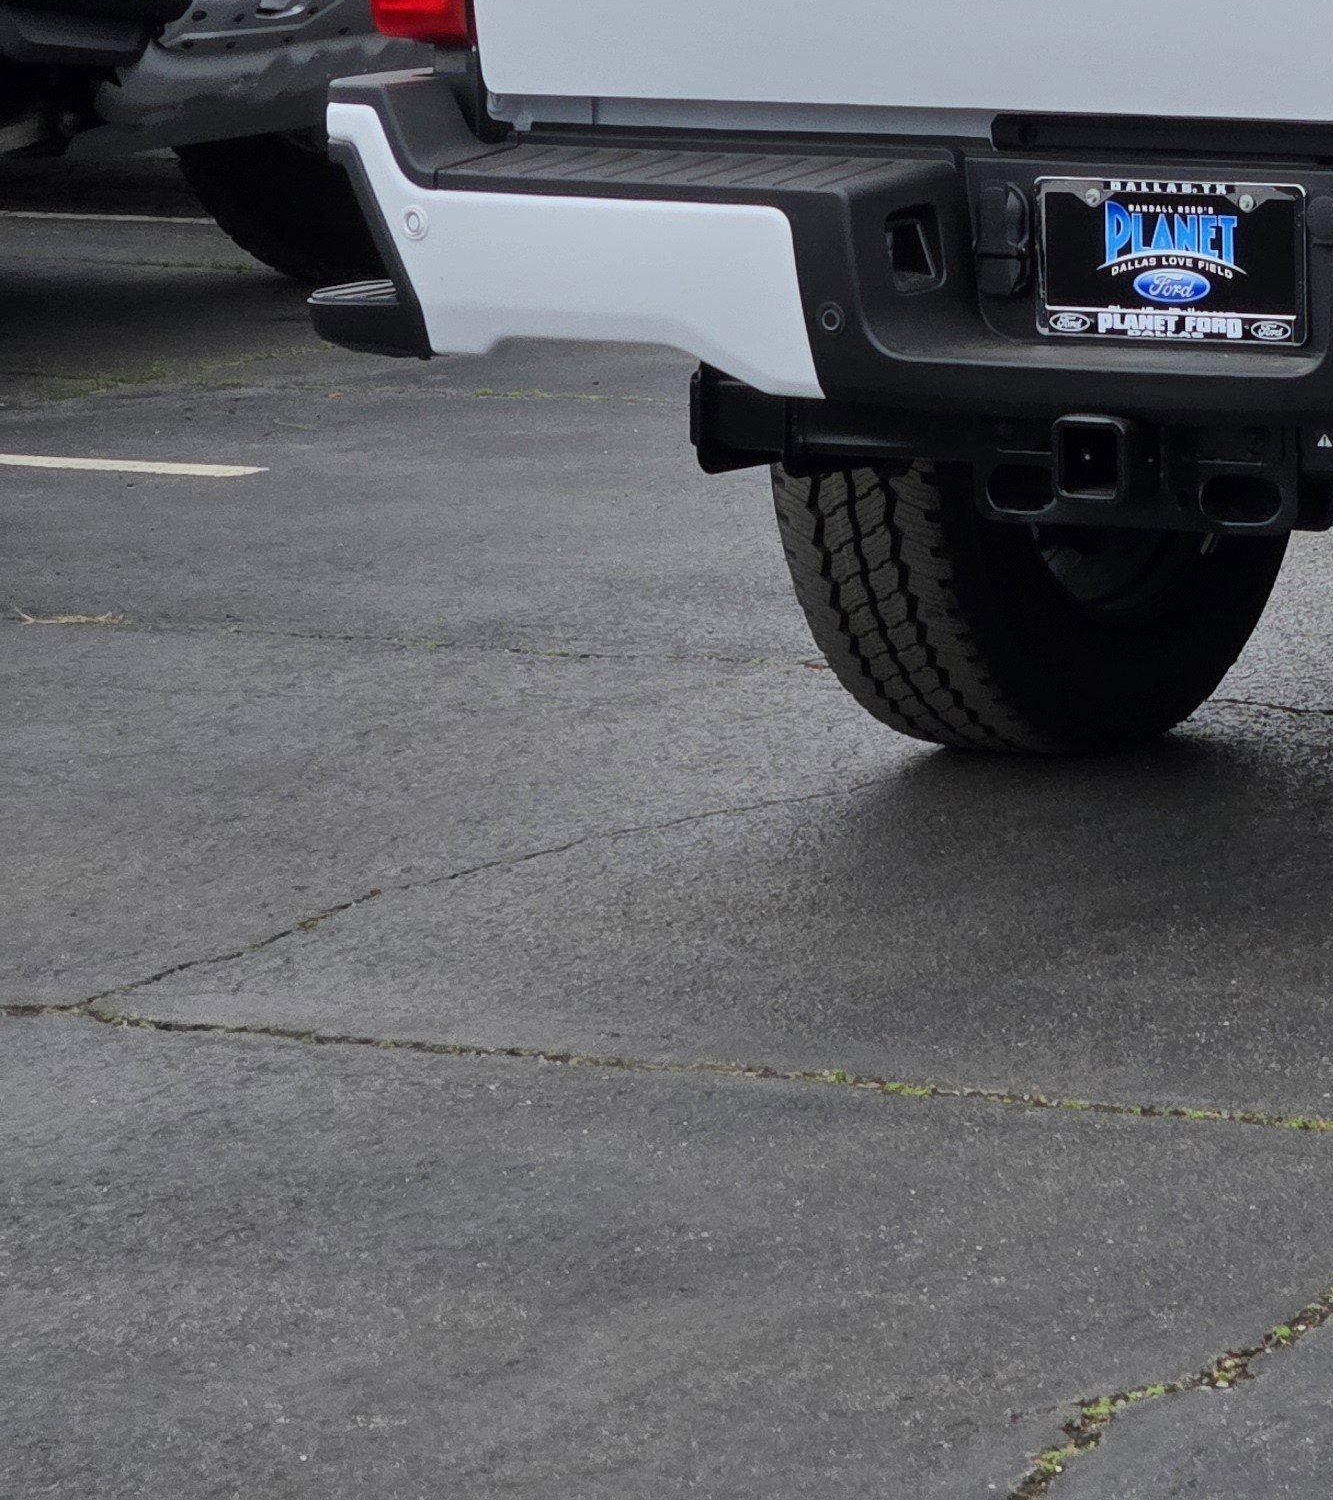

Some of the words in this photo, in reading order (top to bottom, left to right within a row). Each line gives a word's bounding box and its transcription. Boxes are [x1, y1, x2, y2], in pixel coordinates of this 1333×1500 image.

[1104, 199, 1238, 266] PLANET
[1110, 256, 1157, 277] DALLAS
[1161, 255, 1194, 267] LOVE
[1197, 259, 1235, 280] FIELD
[1149, 273, 1196, 299] Ford
[1056, 315, 1086, 329] Ford
[1096, 312, 1179, 334] PLANET
[1184, 316, 1243, 339] FORD
[1257, 324, 1285, 337] Ford
